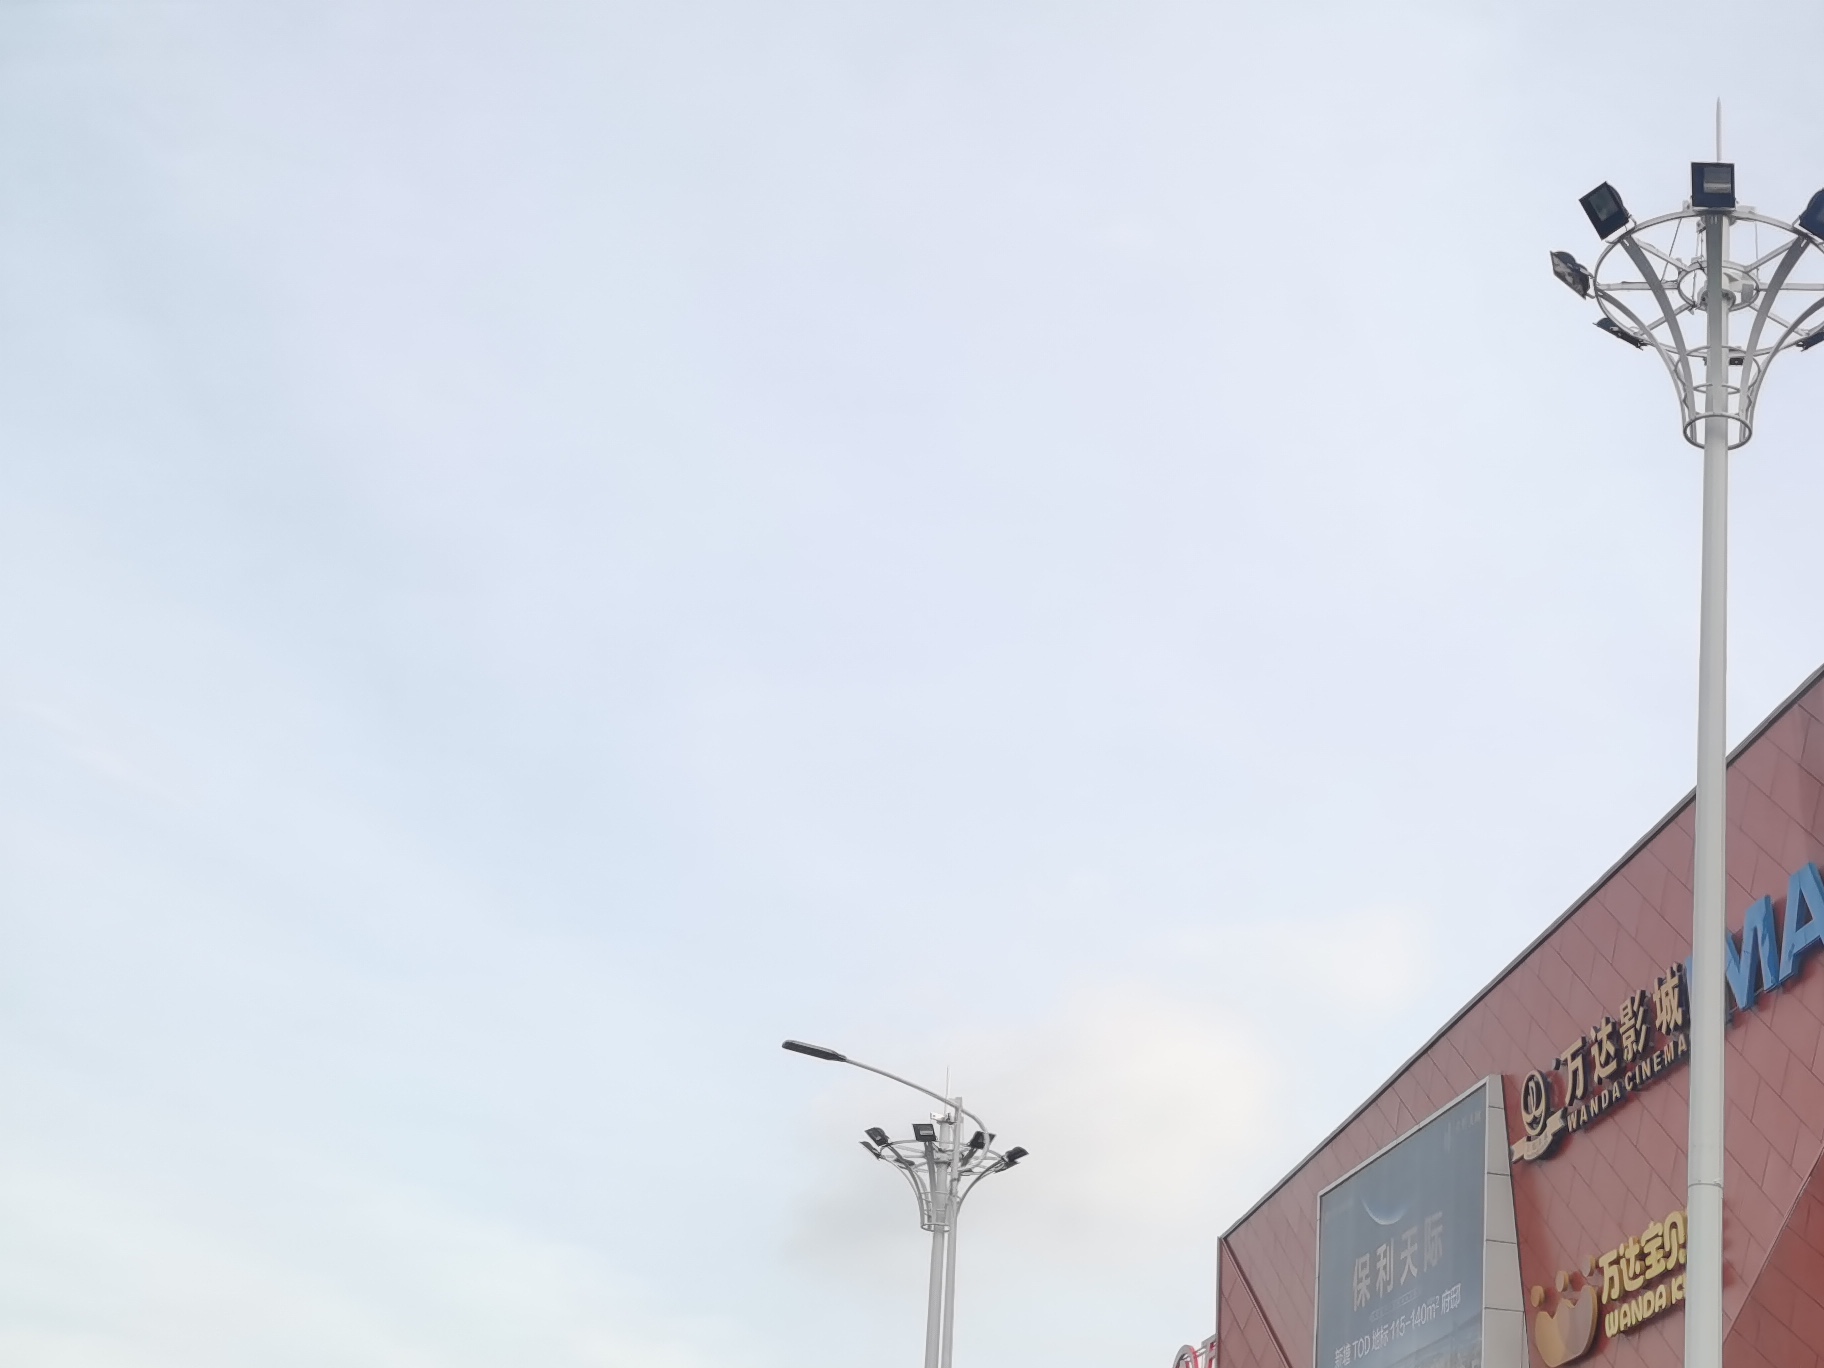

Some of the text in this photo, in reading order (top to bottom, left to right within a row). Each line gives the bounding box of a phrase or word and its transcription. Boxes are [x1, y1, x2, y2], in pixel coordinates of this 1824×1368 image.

[1560, 963, 1683, 1107] 万达影城
[1567, 1032, 1688, 1132] WANDA CINEMA
[1352, 1210, 1444, 1313] 保利天际
[1604, 1284, 1667, 1338] WANDA
